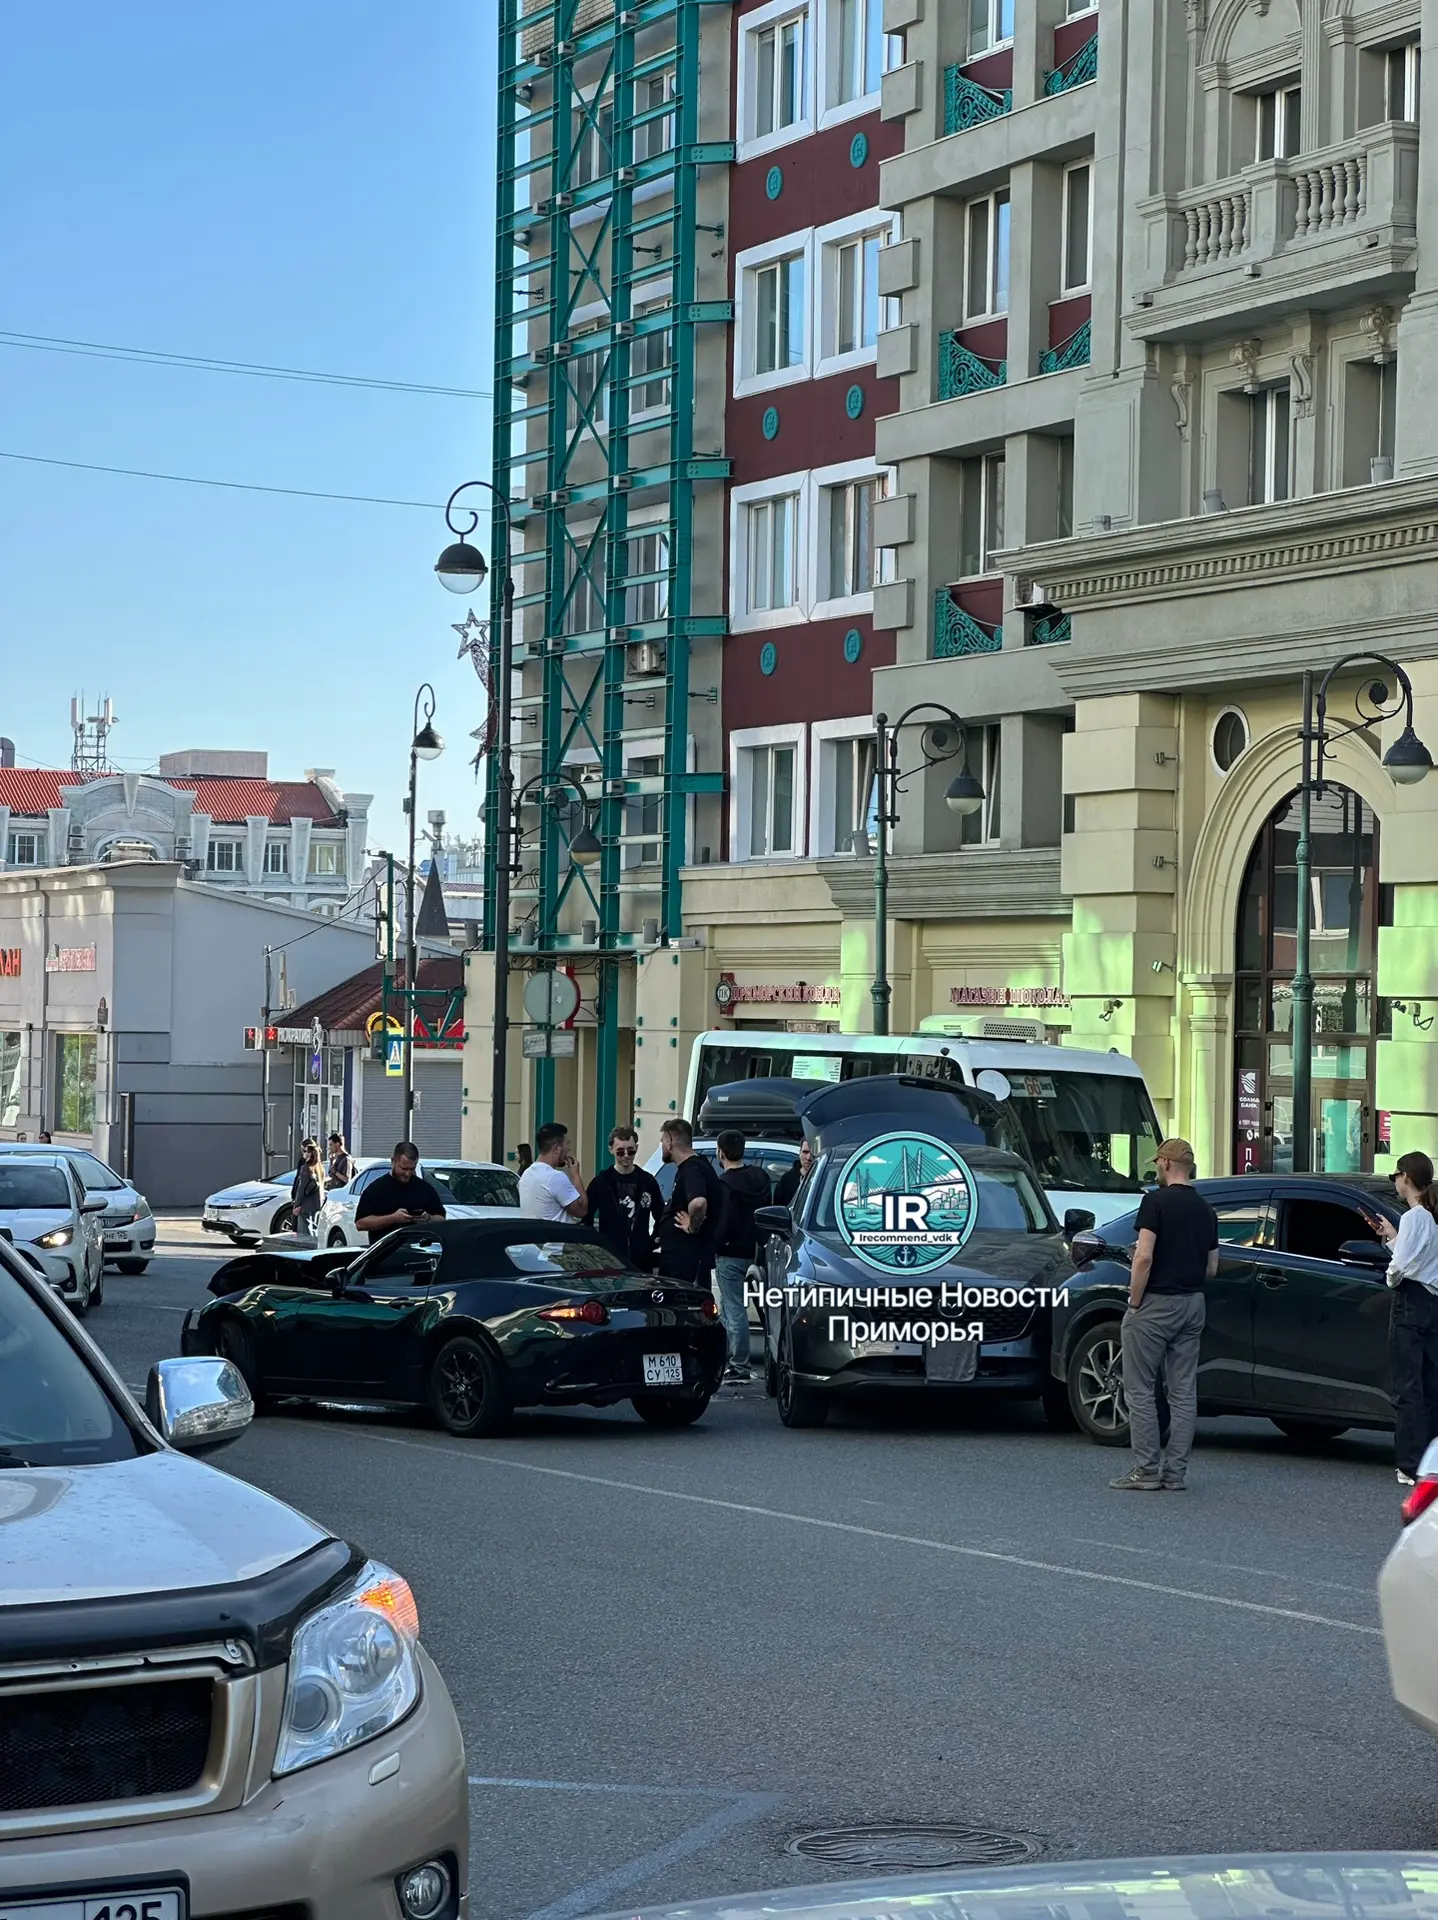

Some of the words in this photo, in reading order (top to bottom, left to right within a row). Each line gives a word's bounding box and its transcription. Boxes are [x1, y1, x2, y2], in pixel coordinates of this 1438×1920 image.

[950, 987, 1006, 1004] МАГАЗИН
[1024, 1076, 1042, 1095] 66
[659, 1355, 676, 1367] 610
[665, 1368, 681, 1378] 125
